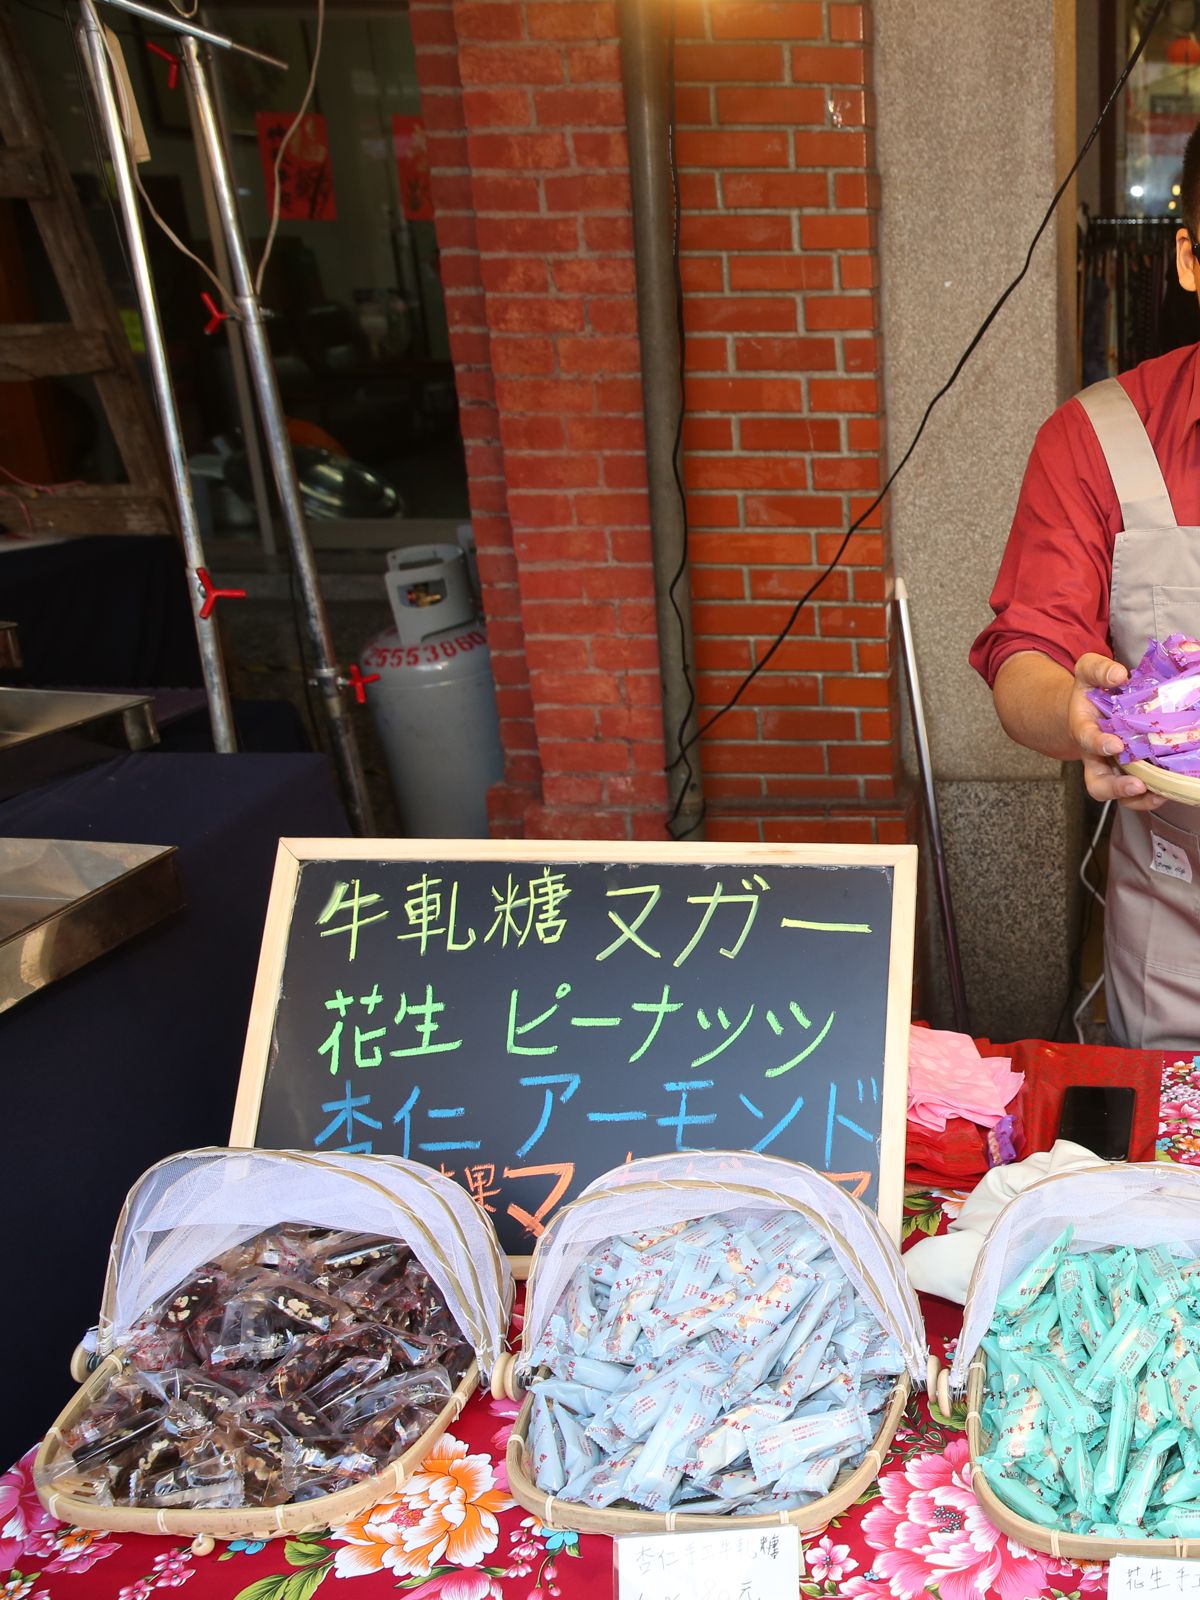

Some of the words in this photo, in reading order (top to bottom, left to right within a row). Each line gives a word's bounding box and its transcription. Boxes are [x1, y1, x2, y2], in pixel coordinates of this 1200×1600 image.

[316, 868, 573, 961] 牛軋糖
[318, 984, 462, 1075] 花生
[314, 1079, 481, 1160] 杏仁
[516, 1073, 878, 1169] アーモンド
